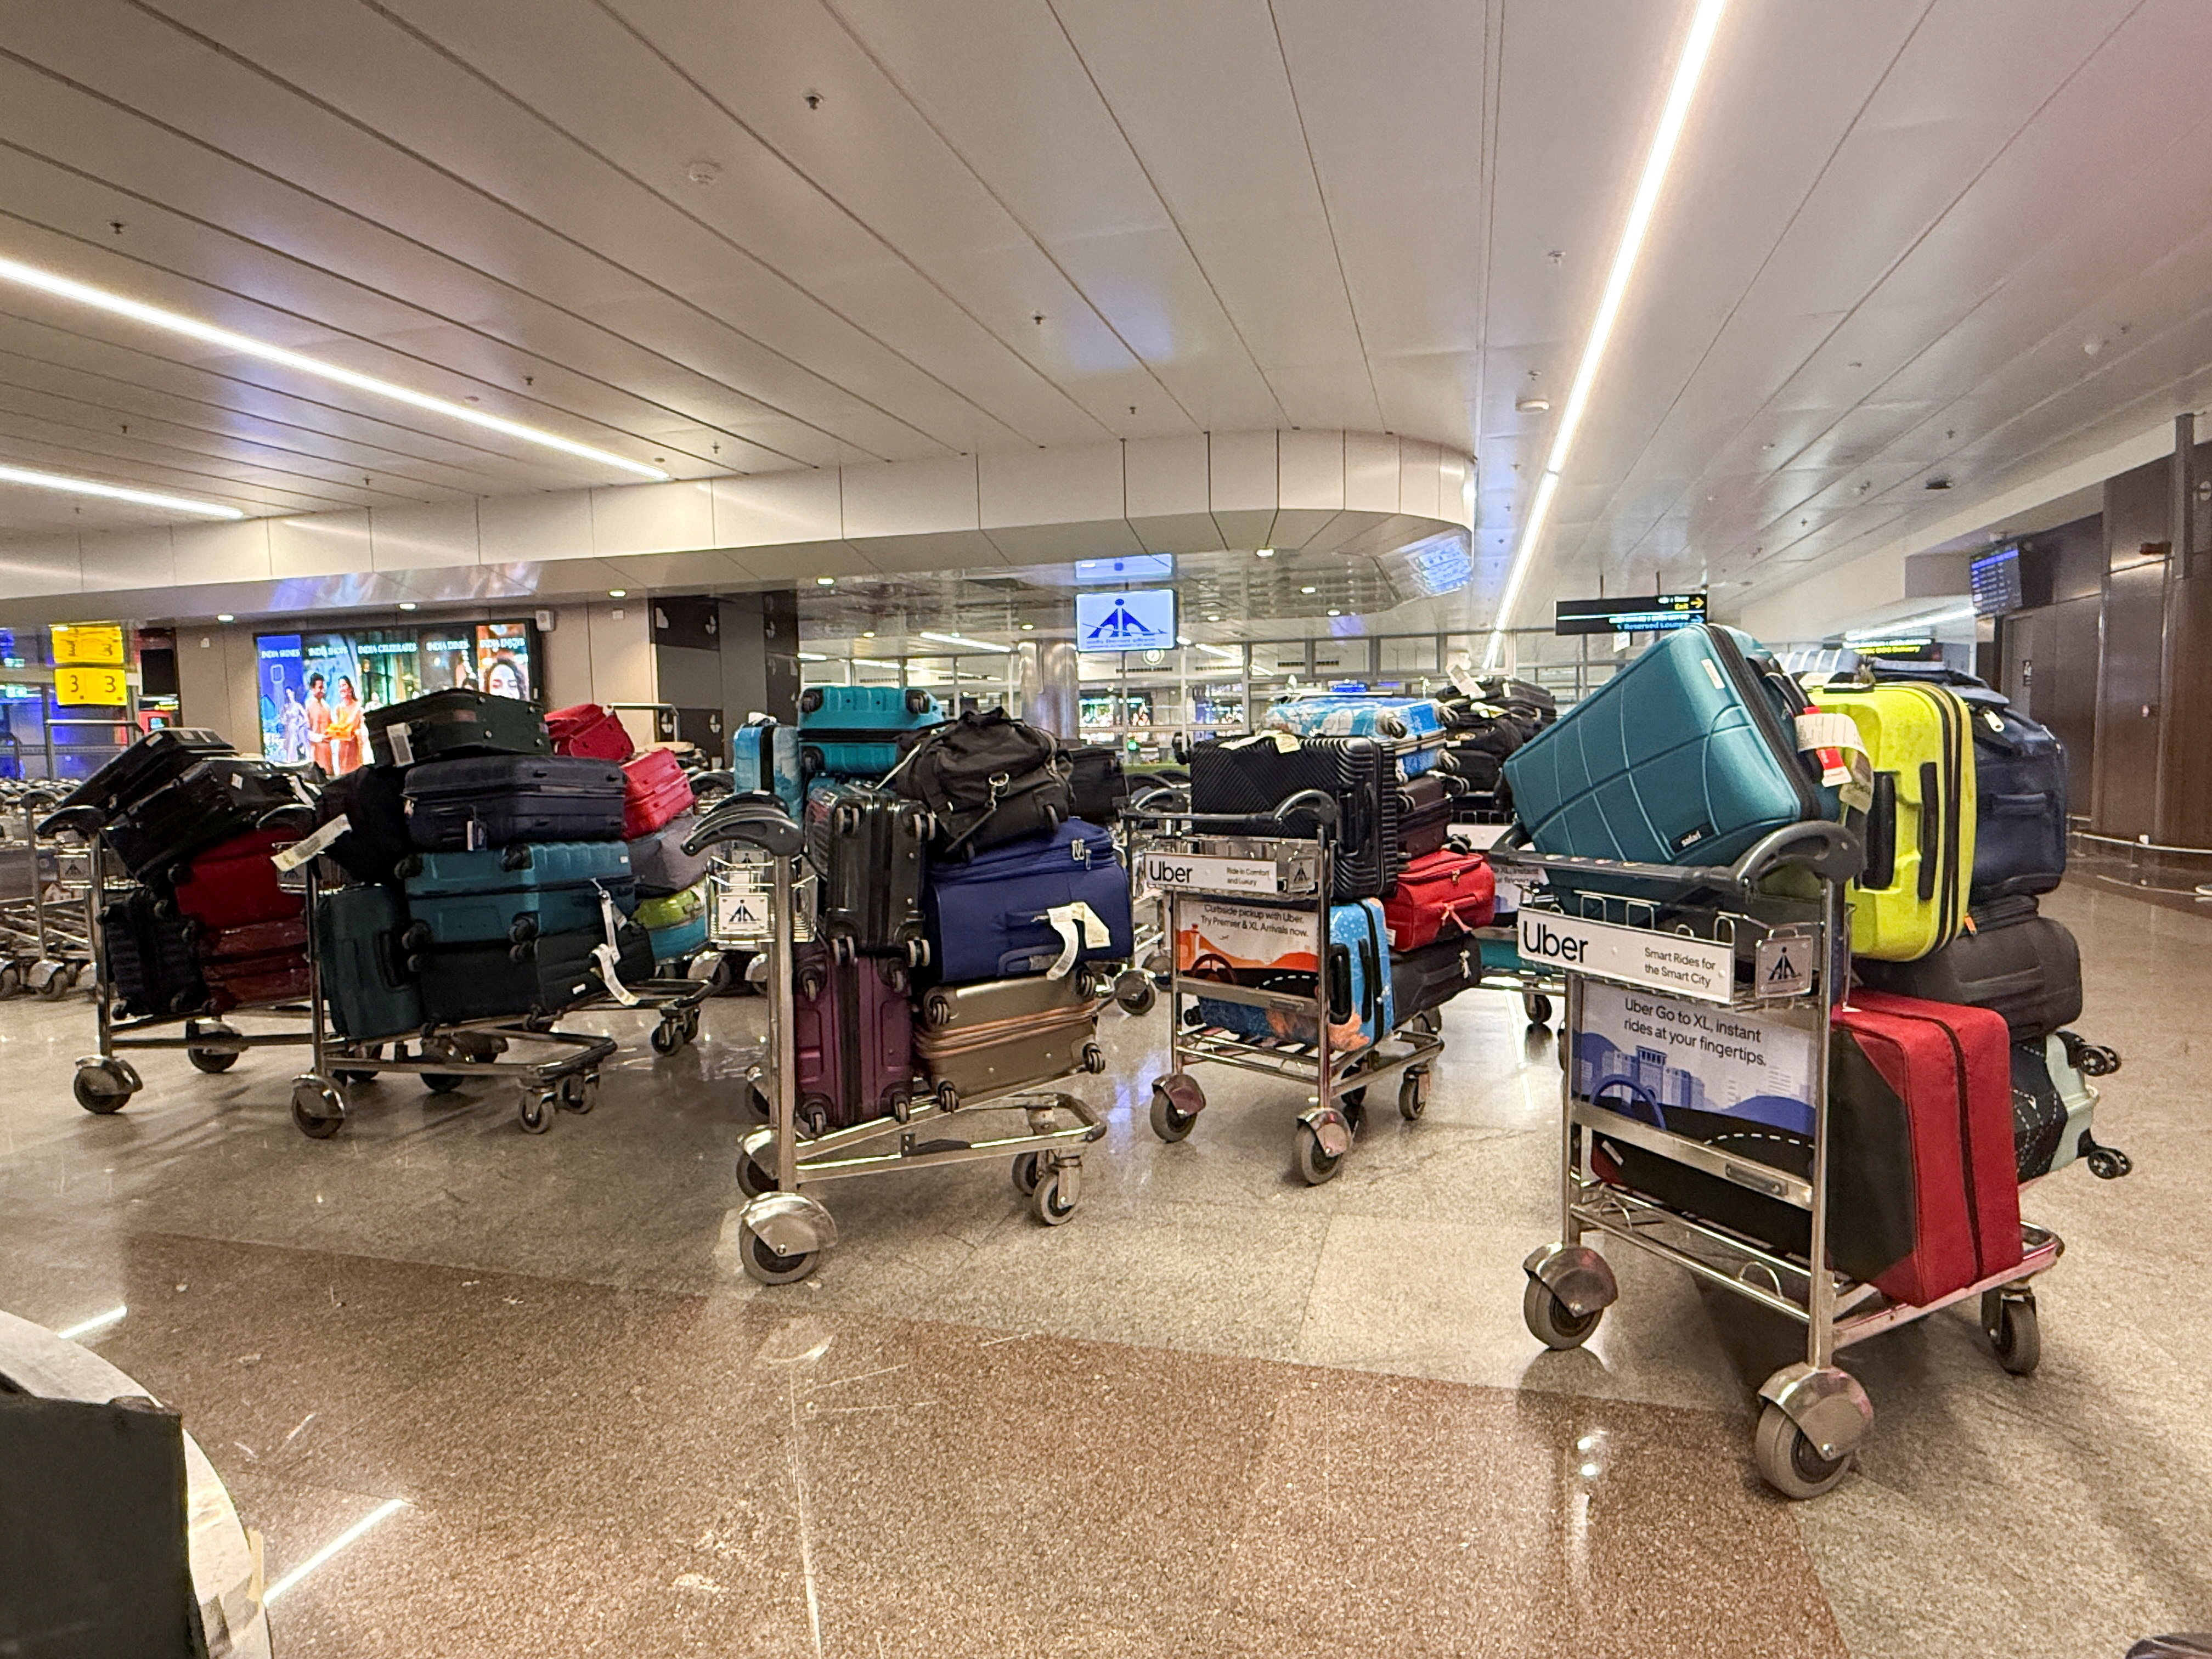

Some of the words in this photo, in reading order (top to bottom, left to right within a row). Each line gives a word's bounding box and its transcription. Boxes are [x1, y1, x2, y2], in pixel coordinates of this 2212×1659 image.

[1624, 622, 1659, 630] Reserved
[358, 644, 377, 654] INDIA
[70, 674, 79, 693] 3
[104, 675, 116, 693] 3
[1150, 860, 1193, 883] Uber
[1201, 915, 1212, 926] Try
[1212, 917, 1241, 928] Premier
[1242, 921, 1248, 929] &
[1249, 921, 1259, 931] XL
[1260, 923, 1288, 934] Arrivals
[1204, 905, 1237, 916] Curbside
[1239, 909, 1264, 920] pickup
[1265, 912, 1282, 921] with
[1523, 921, 1589, 963] Uber
[1645, 947, 1672, 961] Smart
[1673, 952, 1700, 967] Rides
[1701, 956, 1716, 970] for
[1645, 963, 1660, 976] the
[1661, 966, 1689, 981] Smart
[1690, 972, 1712, 989] City
[1625, 997, 1653, 1016] Uber
[1656, 1005, 1675, 1022] Go
[1678, 1011, 1691, 1025] to
[1693, 1013, 1714, 1033] XL,
[1716, 1019, 1762, 1043] instant
[1624, 1018, 1652, 1036] rides
[1655, 1027, 1667, 1040] at
[1669, 1031, 1697, 1047] your
[1700, 1036, 1767, 1066] fingertips.
